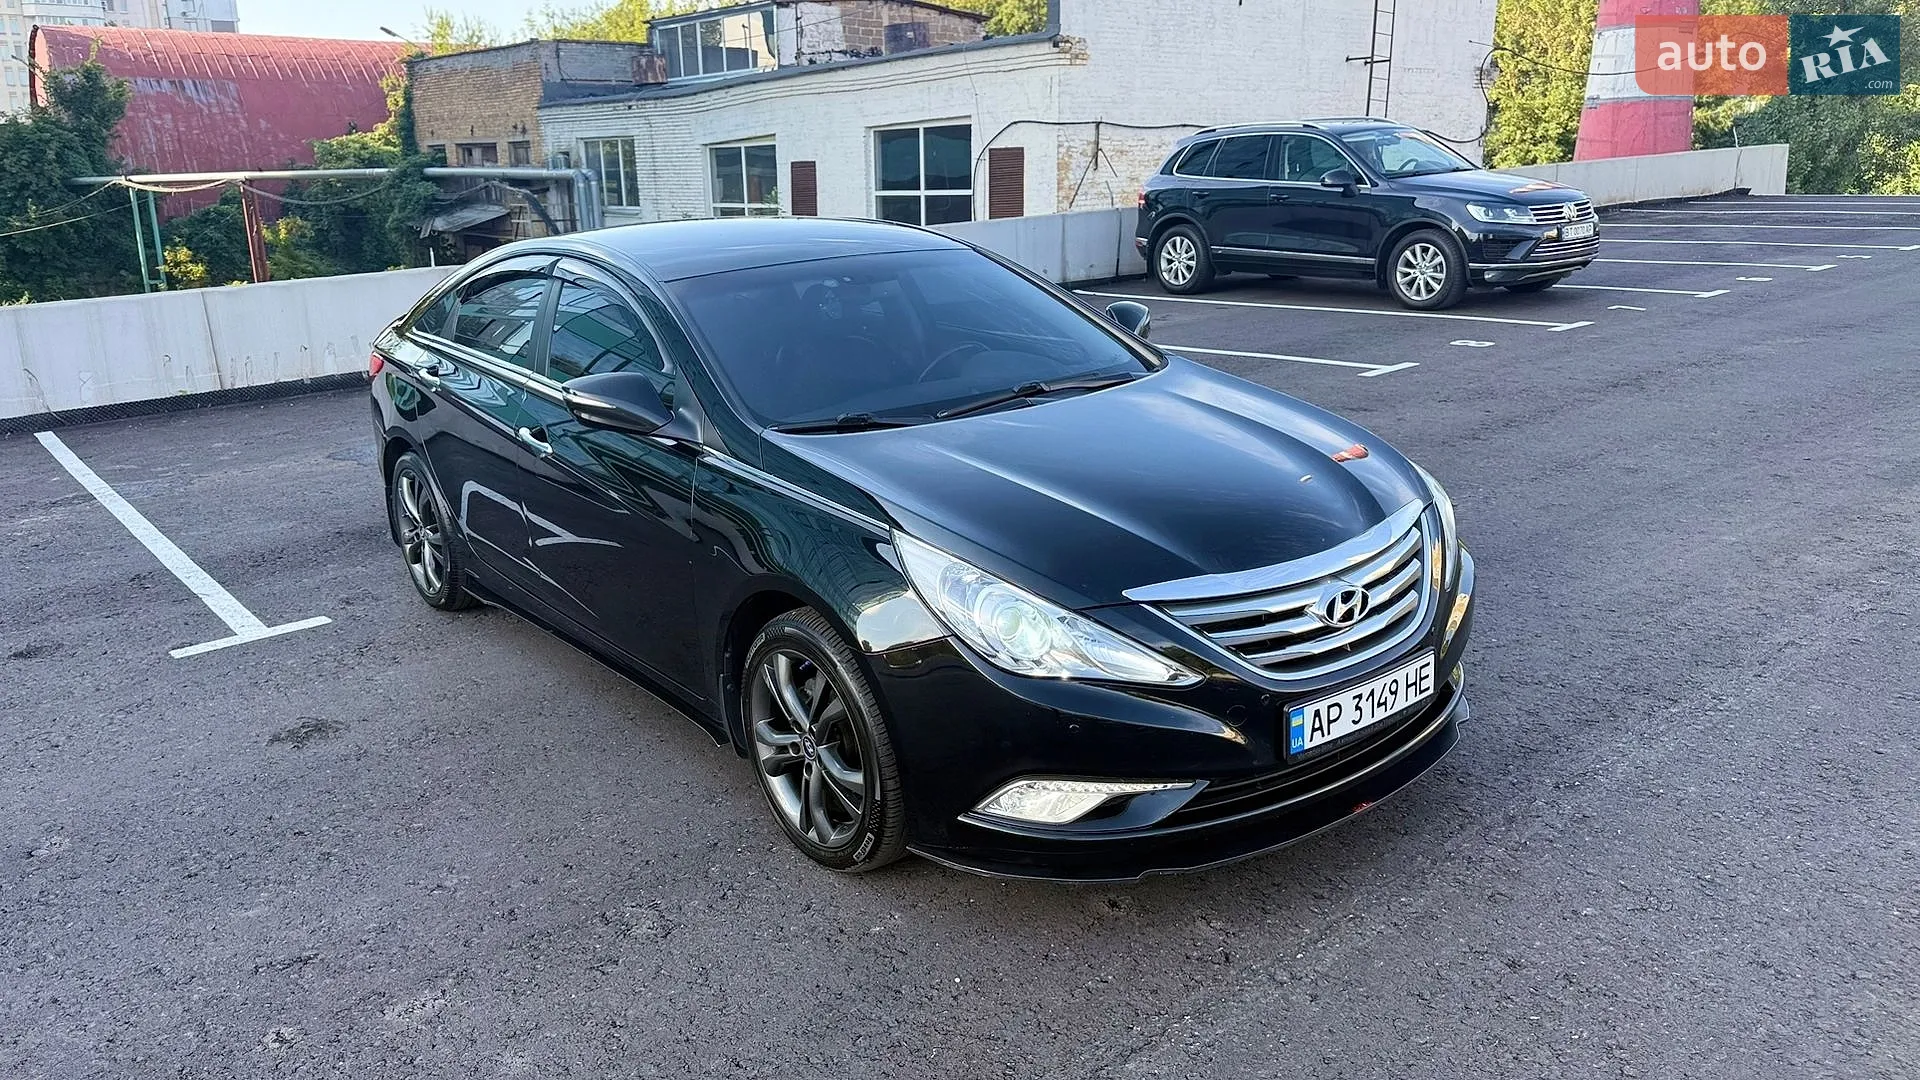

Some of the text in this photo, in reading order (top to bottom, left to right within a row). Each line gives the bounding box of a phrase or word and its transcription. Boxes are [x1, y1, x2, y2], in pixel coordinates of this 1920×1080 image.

[1309, 702, 1342, 743] AP
[1351, 679, 1399, 725] 3149
[1405, 662, 1431, 702] HE
[1292, 738, 1304, 749] UA
